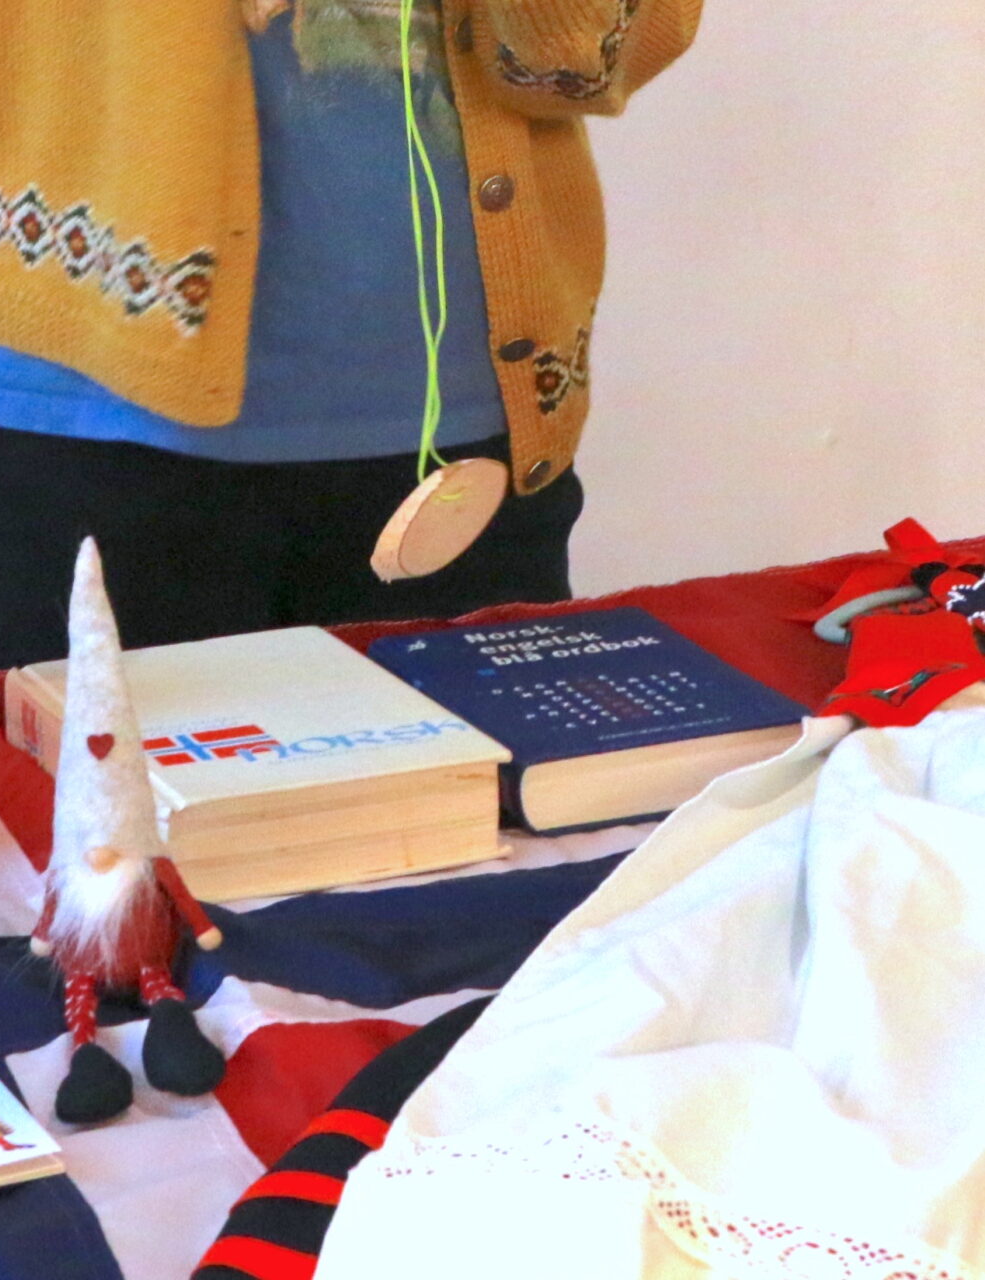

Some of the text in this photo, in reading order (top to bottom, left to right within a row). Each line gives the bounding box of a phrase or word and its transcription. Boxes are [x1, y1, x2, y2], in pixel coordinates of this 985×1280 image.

[464, 623, 565, 644] Norsk-
[479, 630, 603, 656] engelsk
[551, 635, 662, 659] ordbok
